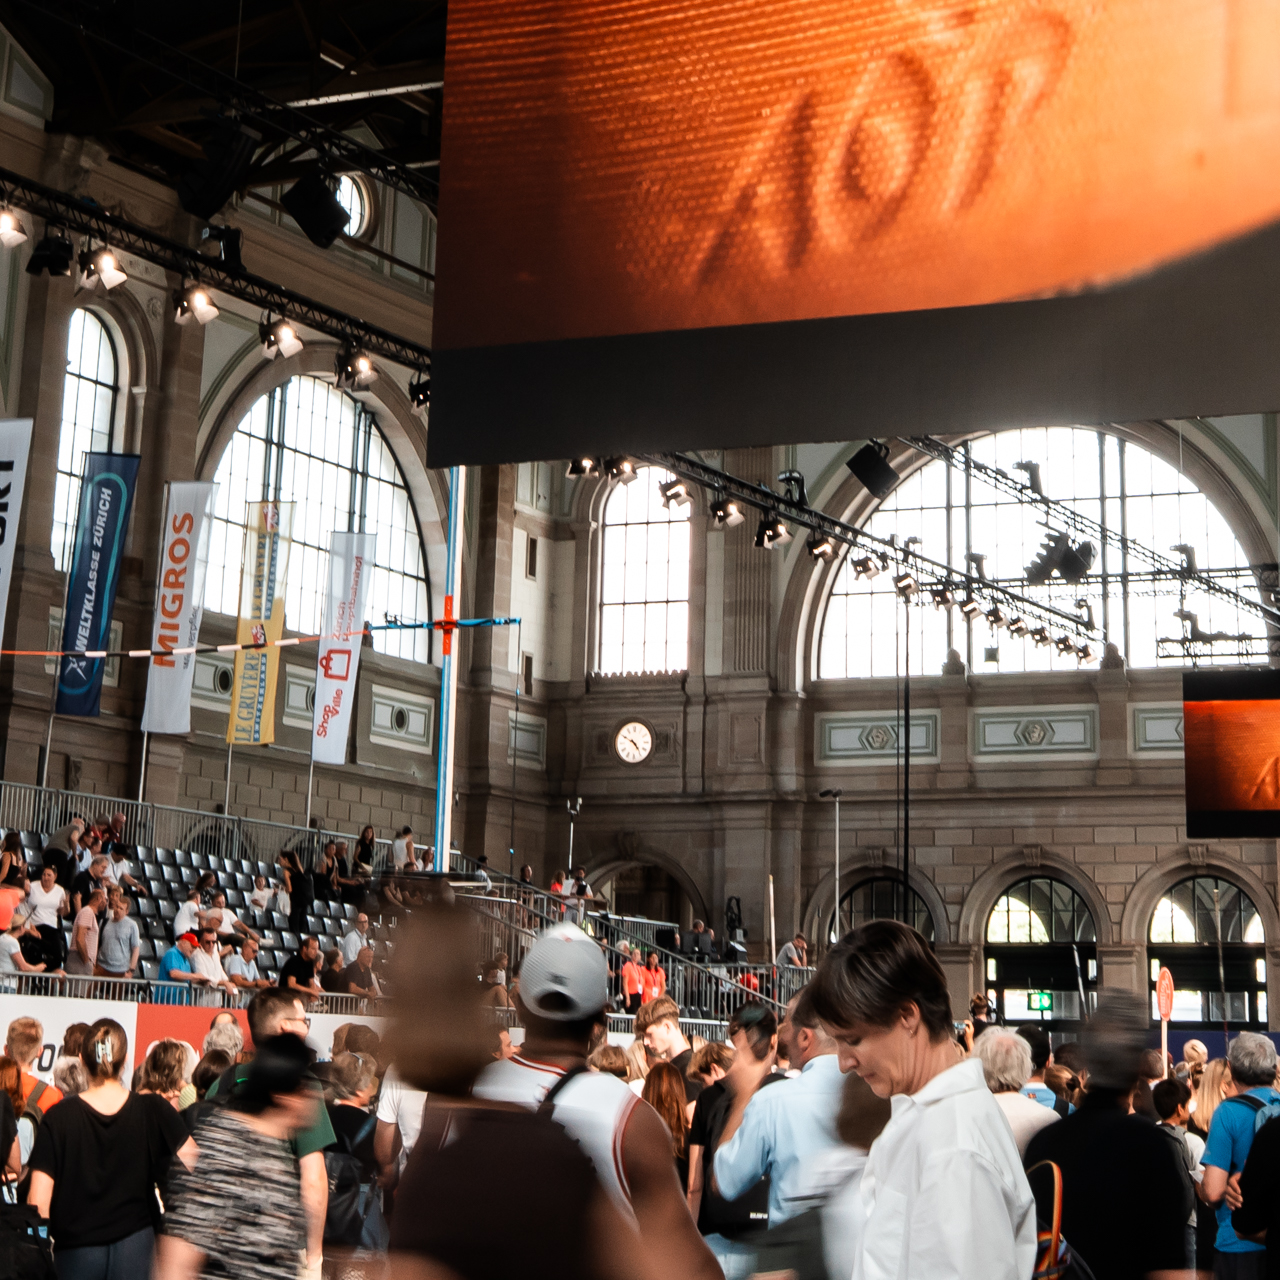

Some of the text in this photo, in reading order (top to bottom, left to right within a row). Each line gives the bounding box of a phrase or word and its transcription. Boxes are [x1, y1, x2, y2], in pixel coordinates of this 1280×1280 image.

[74, 487, 112, 652] WELTKLASSE ZÜRICH
[153, 512, 194, 669] MIGROS
[342, 556, 364, 642] Hauptbahnhof
[333, 602, 346, 641] Zürich
[235, 651, 260, 742] LE GRUYÈRE
[254, 655, 266, 739] SWITZERLAND
[317, 705, 331, 738] Shop
[330, 688, 343, 719] Ville
